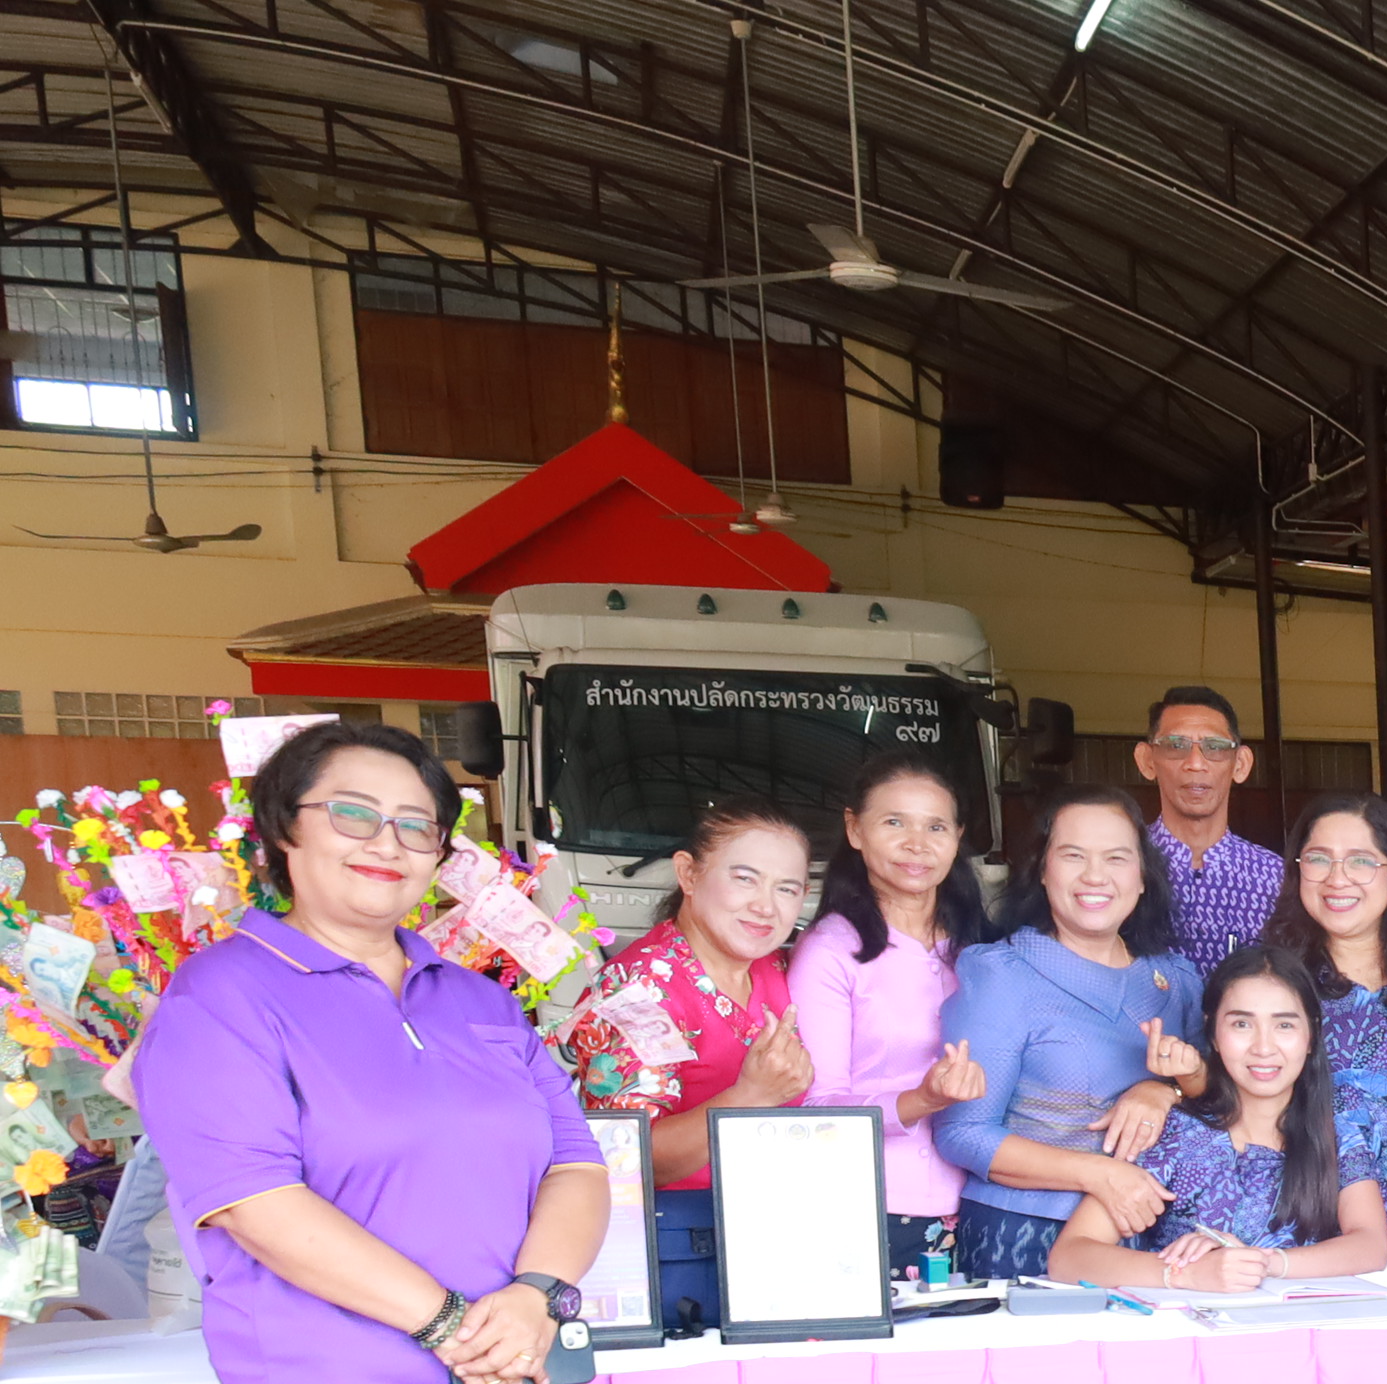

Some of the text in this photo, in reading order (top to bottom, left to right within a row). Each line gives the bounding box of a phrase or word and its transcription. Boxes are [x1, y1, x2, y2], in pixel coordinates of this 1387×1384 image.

[585, 679, 940, 716] สำนักงานปลัดกระทรวงวัฒนธรรม
[895, 721, 941, 743] ๙๗
[590, 892, 662, 906] HIN
